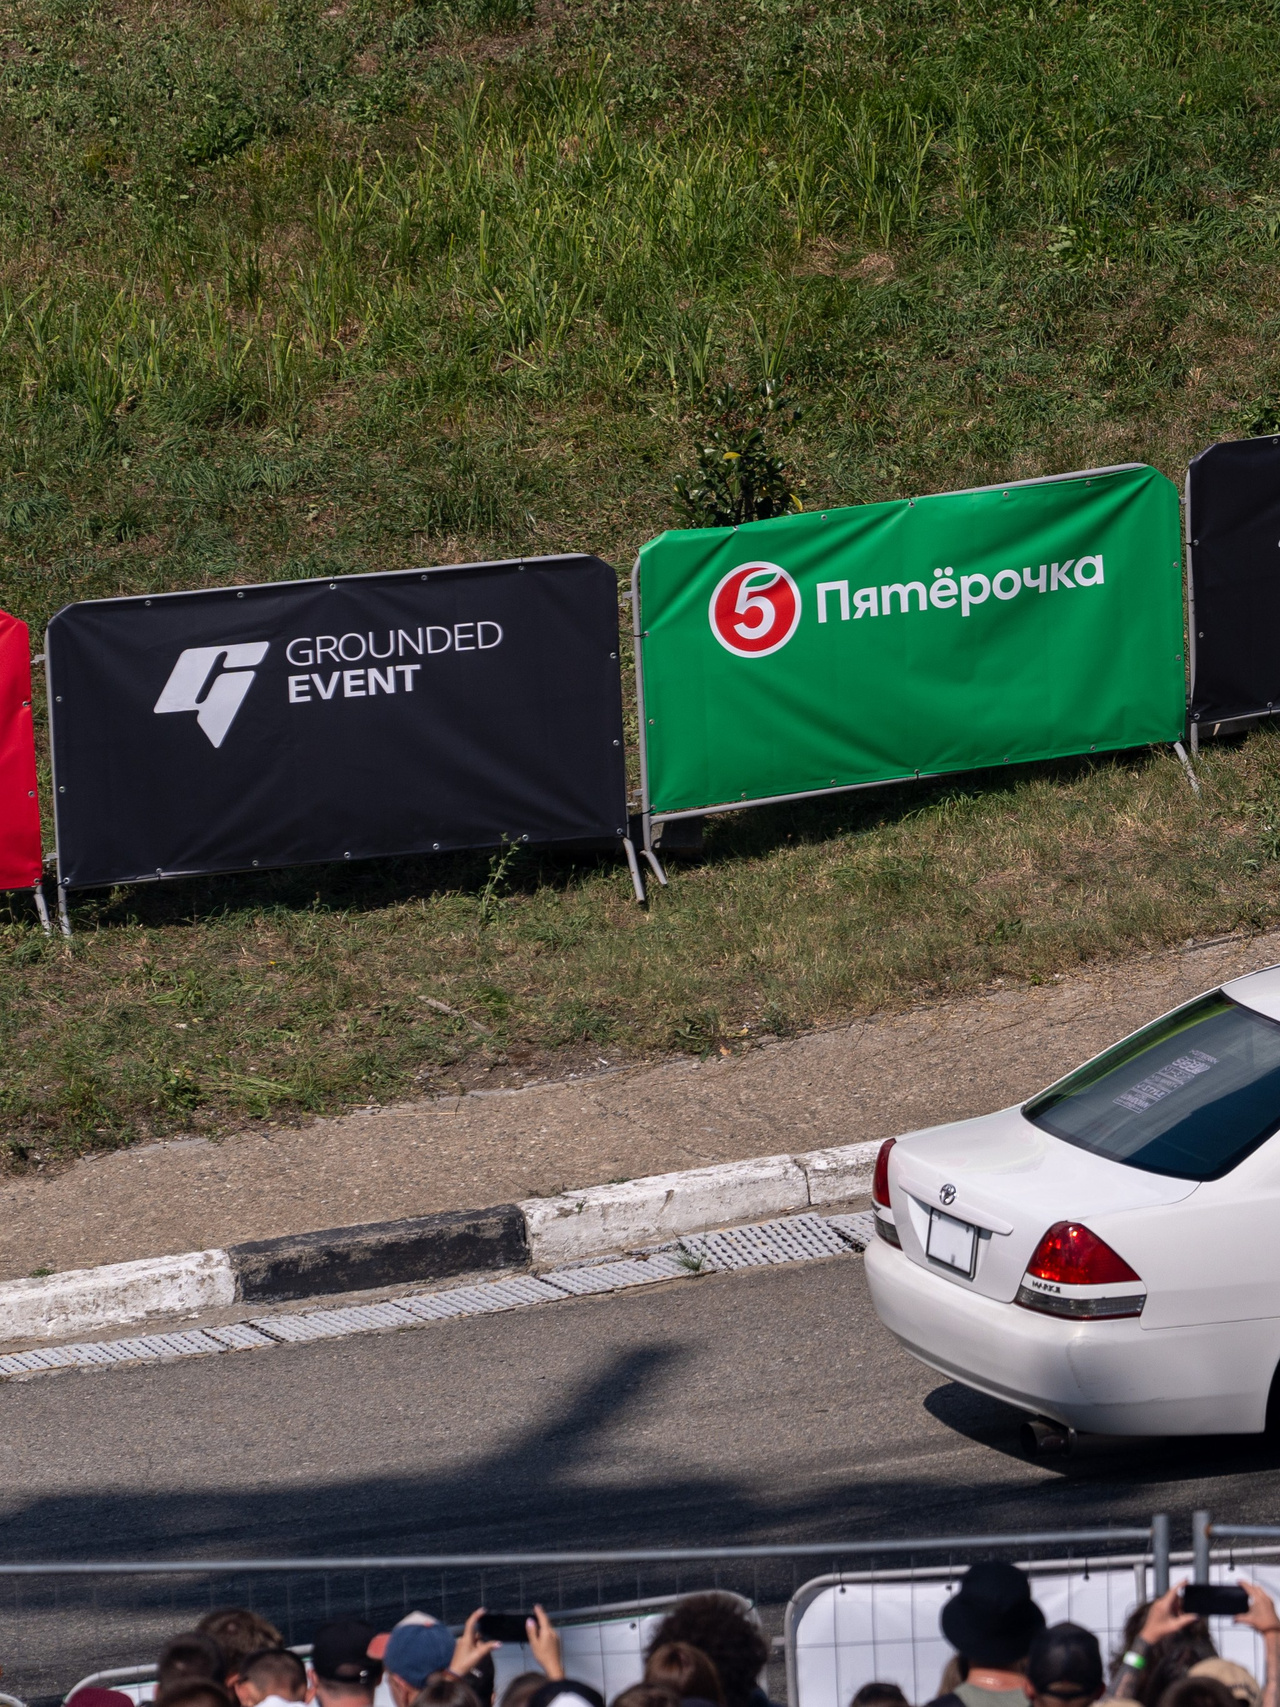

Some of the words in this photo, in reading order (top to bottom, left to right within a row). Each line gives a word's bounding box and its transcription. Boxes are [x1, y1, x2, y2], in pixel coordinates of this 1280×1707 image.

[734, 566, 780, 640] 5
[816, 554, 1105, 624] Пятёрочка
[285, 620, 504, 667] GROUNDED
[287, 663, 422, 704] EVENT
